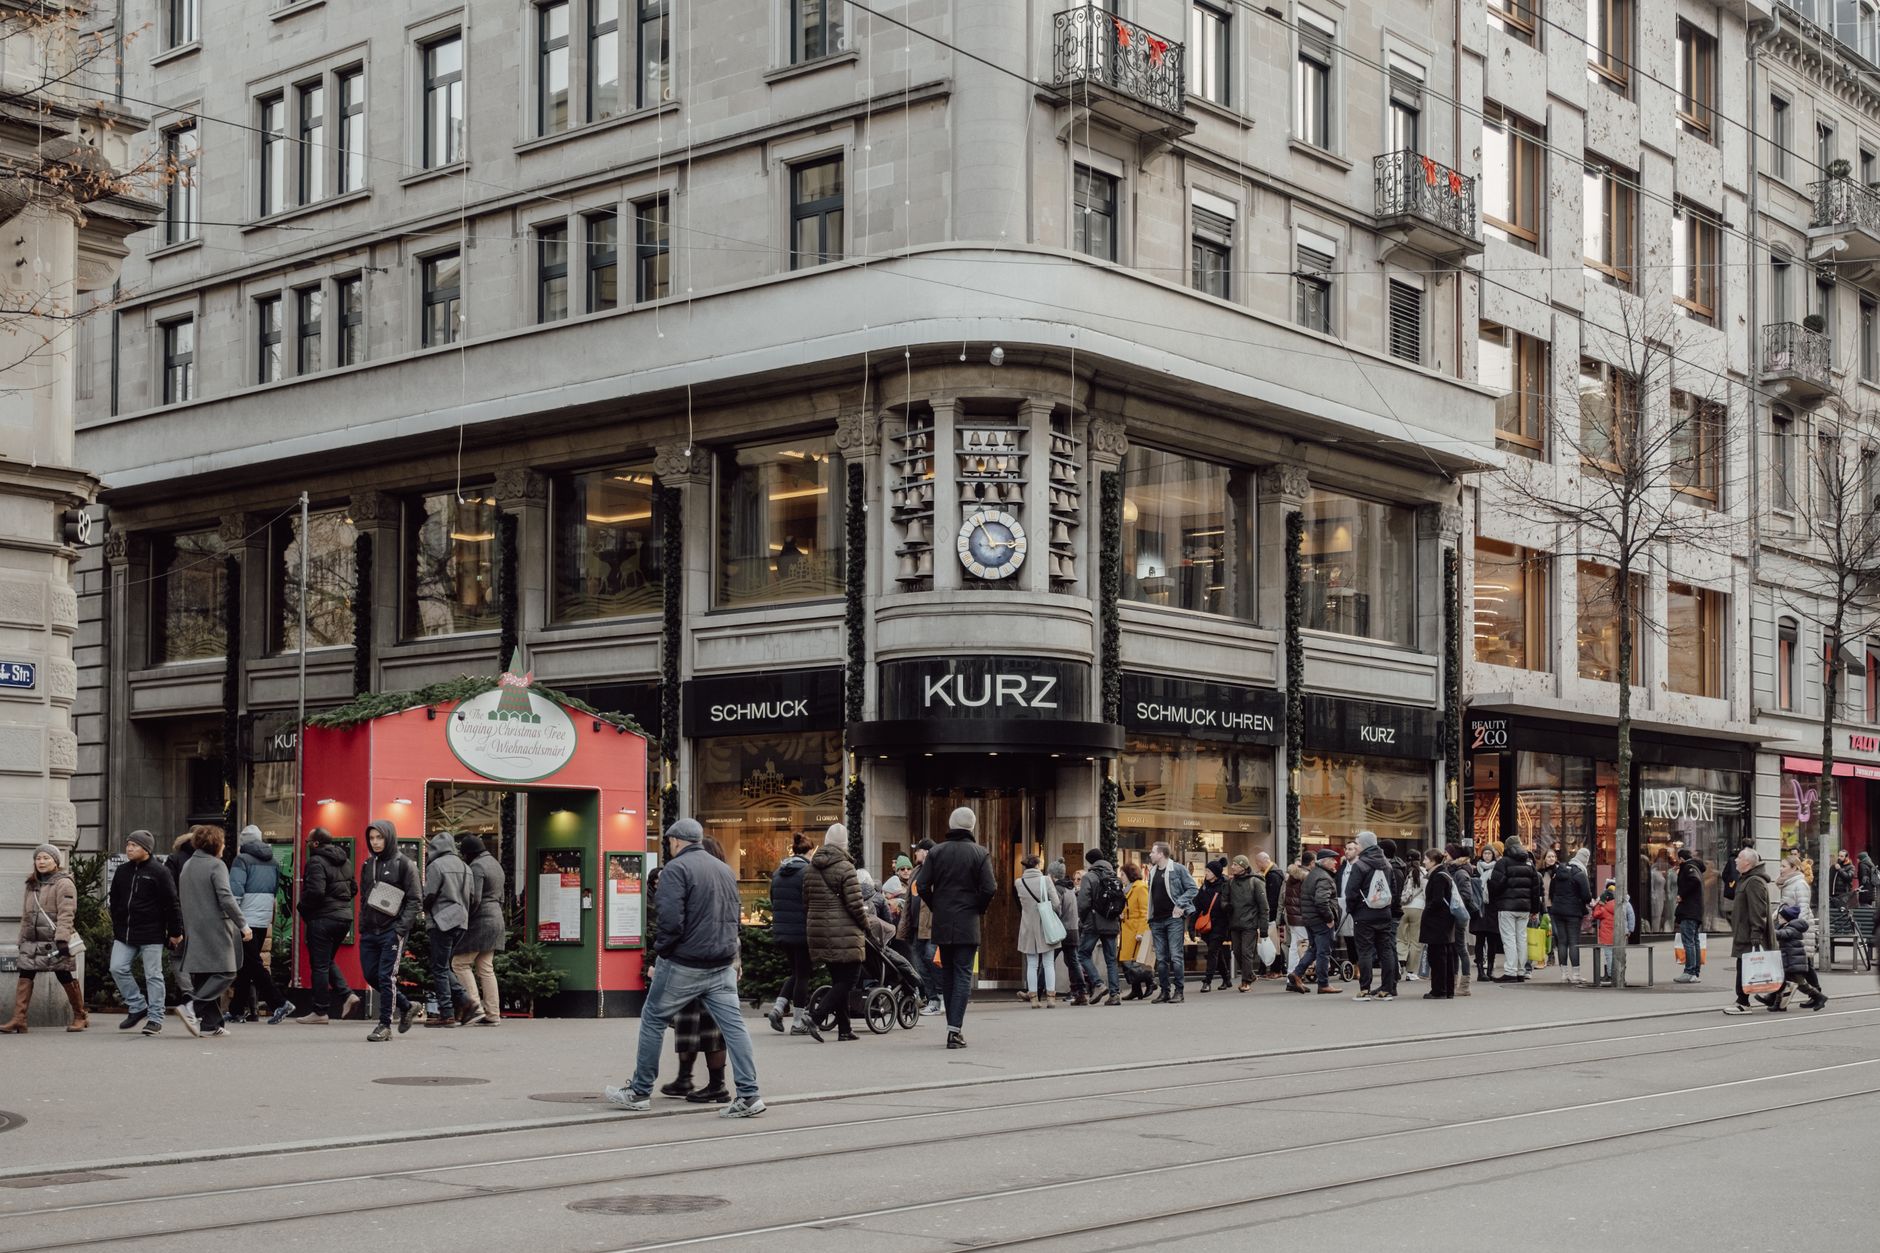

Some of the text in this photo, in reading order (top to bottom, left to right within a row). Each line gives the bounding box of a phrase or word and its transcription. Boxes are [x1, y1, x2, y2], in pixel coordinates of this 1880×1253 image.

[78, 509, 92, 546] 82
[12, 665, 30, 682] Str.
[924, 673, 1058, 709] KURZ
[710, 699, 809, 722] SCHMUCK
[1136, 702, 1274, 732] SCHMUCK UHREN
[455, 720, 566, 741] Singing Christmas Tree
[1360, 725, 1396, 744] KURZ
[1471, 719, 1507, 730] BEAUTY
[1471, 727, 1508, 750] 2GO
[1849, 734, 1879, 752] TALLY
